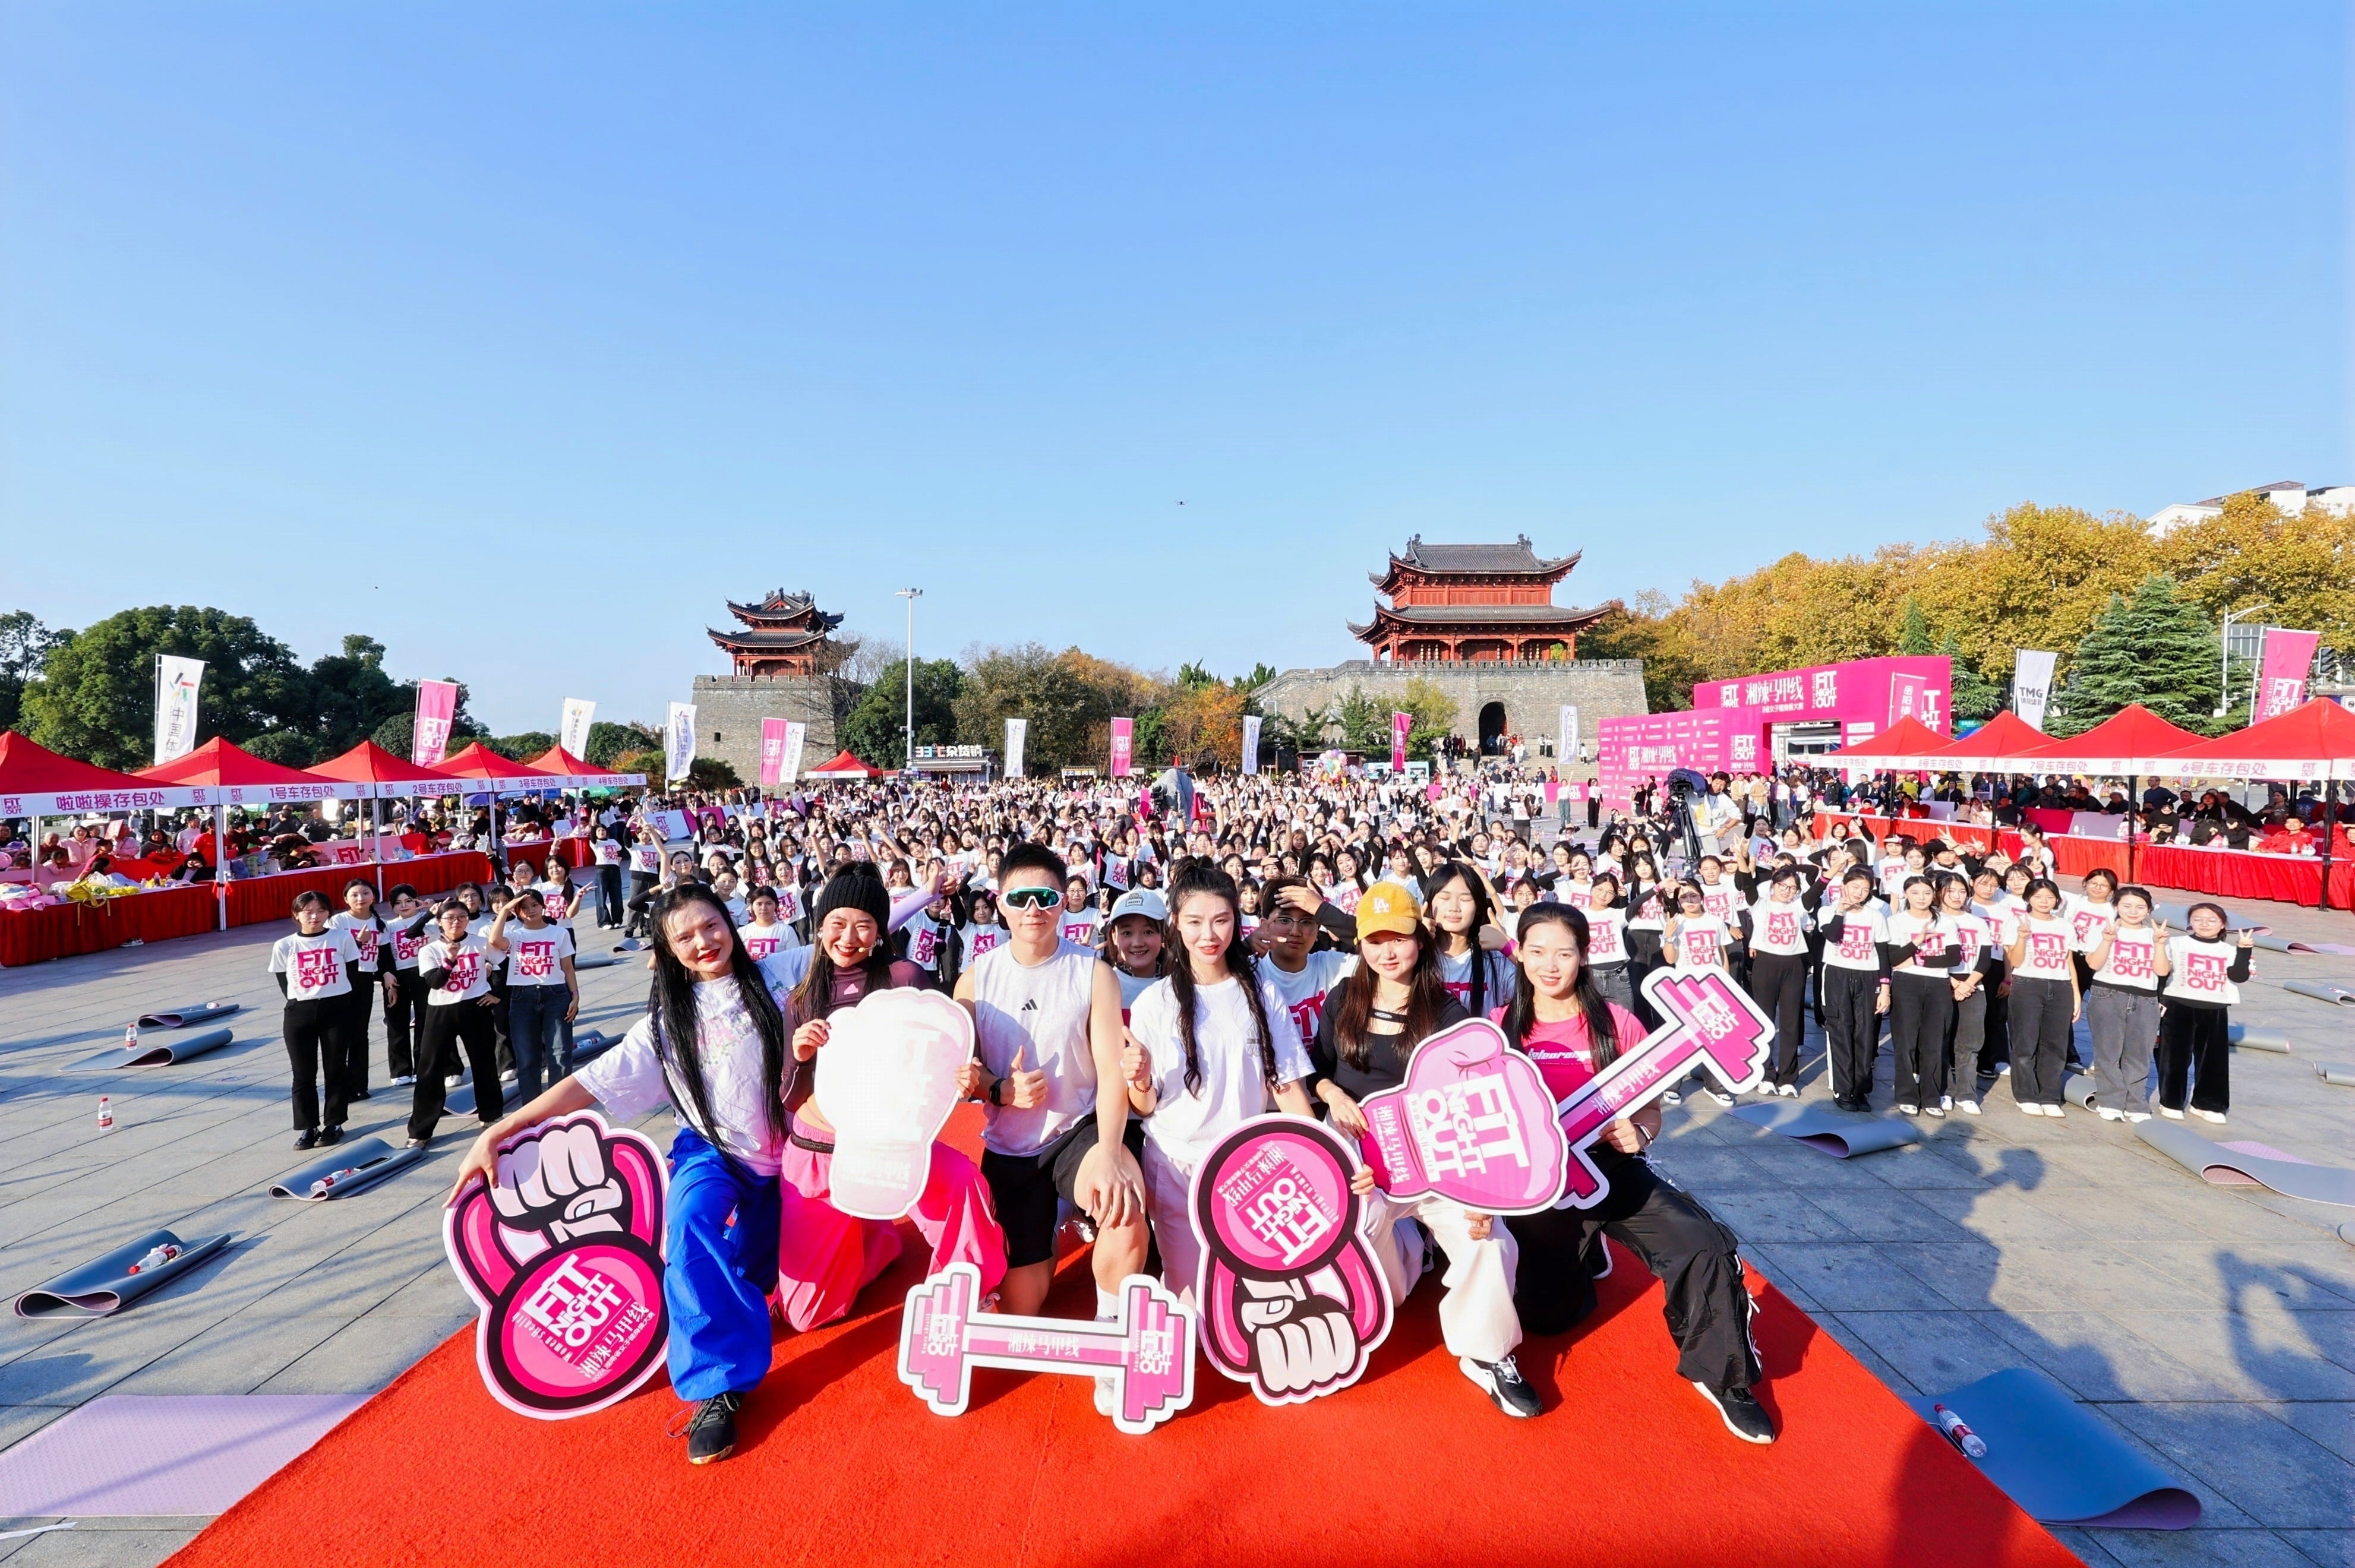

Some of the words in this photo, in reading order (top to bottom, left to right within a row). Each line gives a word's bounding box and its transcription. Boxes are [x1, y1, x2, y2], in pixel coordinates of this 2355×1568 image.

[1745, 675, 1804, 705] 湘辣马甲线
[2019, 687, 2044, 698] TMG
[1816, 696, 1837, 708] OUT
[422, 738, 443, 748] OUT
[1734, 752, 1756, 760] OUT
[1833, 758, 1867, 767] 9号车存包处
[1918, 758, 1962, 769] 8号车存包处
[2029, 761, 2088, 772] 7号车存包处
[2182, 762, 2267, 776] 6号车存包处
[519, 777, 556, 788] 3号车存包处
[598, 776, 629, 785] 4号车存包处
[269, 785, 336, 799] 1号车存包处
[412, 782, 463, 794] 2号车存包处
[56, 791, 165, 811] 啦啦操存包处
[1373, 897, 1391, 913] LA
[1768, 934, 1797, 946] OUT
[1587, 942, 1617, 954] OUT
[1840, 949, 1871, 960] OUT
[1691, 953, 1716, 966] OUT
[2033, 956, 2066, 970] OUT
[520, 964, 554, 976] OUT
[2113, 964, 2154, 979] OUT
[299, 972, 339, 988] OUT
[2187, 977, 2225, 992] OUT
[1710, 1013, 1740, 1039] OUT
[1593, 1057, 1661, 1116] 湘辣马甲线
[1419, 1089, 1467, 1178] OUT
[1377, 1105, 1410, 1184] 湘辣马甲线
[1221, 1146, 1287, 1207] 湘辣马甲线
[1246, 1177, 1296, 1231] OUT
[564, 1282, 623, 1347] OUT
[576, 1301, 650, 1379] 湘辣马甲线
[1008, 1332, 1079, 1358] 湘辣马甲线
[927, 1342, 958, 1357] OUT
[1139, 1360, 1172, 1376] OUT
